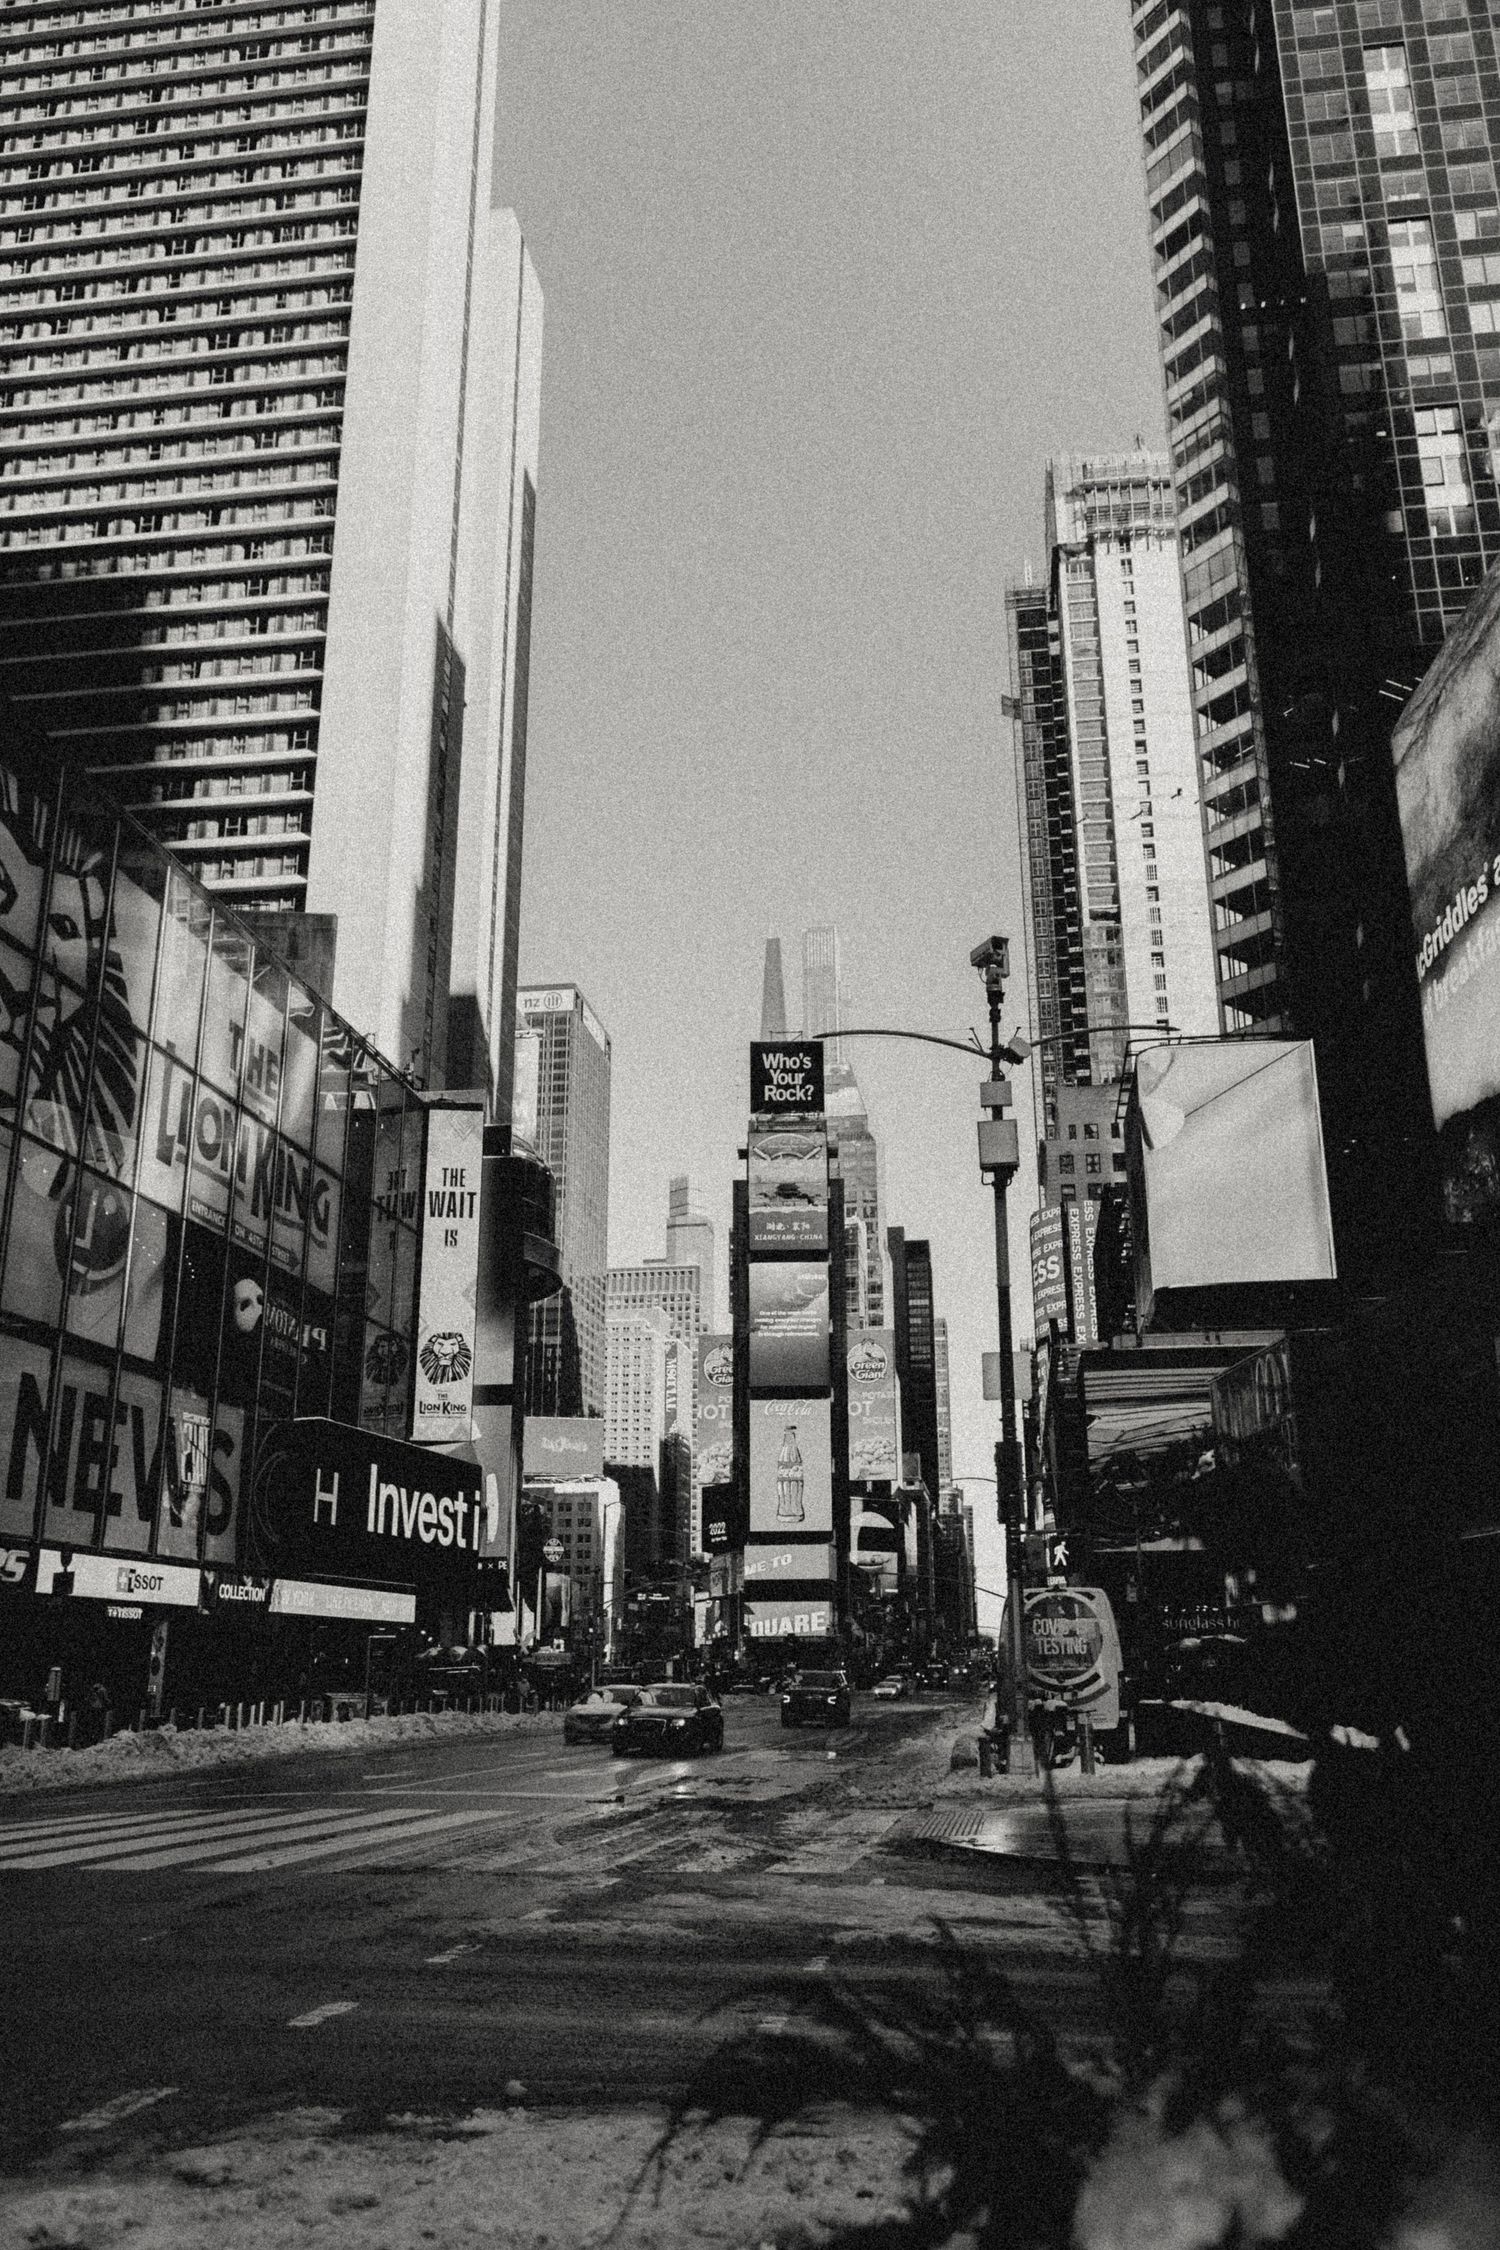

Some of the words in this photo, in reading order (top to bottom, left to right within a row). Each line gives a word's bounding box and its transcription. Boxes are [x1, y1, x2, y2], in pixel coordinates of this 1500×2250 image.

[229, 1019, 279, 1094] THE
[762, 1053, 812, 1069] Who's
[770, 1069, 804, 1085] Your
[764, 1085, 814, 1101] Rock?
[156, 1039, 248, 1184] LION
[251, 1113, 331, 1237] KING
[441, 1167, 467, 1188] THE
[428, 1190, 477, 1219] WAIT
[444, 1229, 459, 1247] IS
[799, 1233, 823, 1241] CHINA
[1069, 1207, 1082, 1261] EXPRESS
[1073, 1265, 1086, 1319] EXPRESS
[710, 1364, 733, 1376] Gree
[851, 1361, 885, 1371] Green
[855, 1369, 887, 1380] Giant
[419, 1401, 441, 1414] LION
[442, 1401, 467, 1415] KING
[6, 1371, 235, 1536] NEWS
[313, 1468, 339, 1526] H
[770, 1553, 792, 1569] TO
[218, 1583, 266, 1602] COLLECTION
[1162, 1615, 1225, 1631] sunglass
[1035, 1637, 1088, 1655] TESTING
